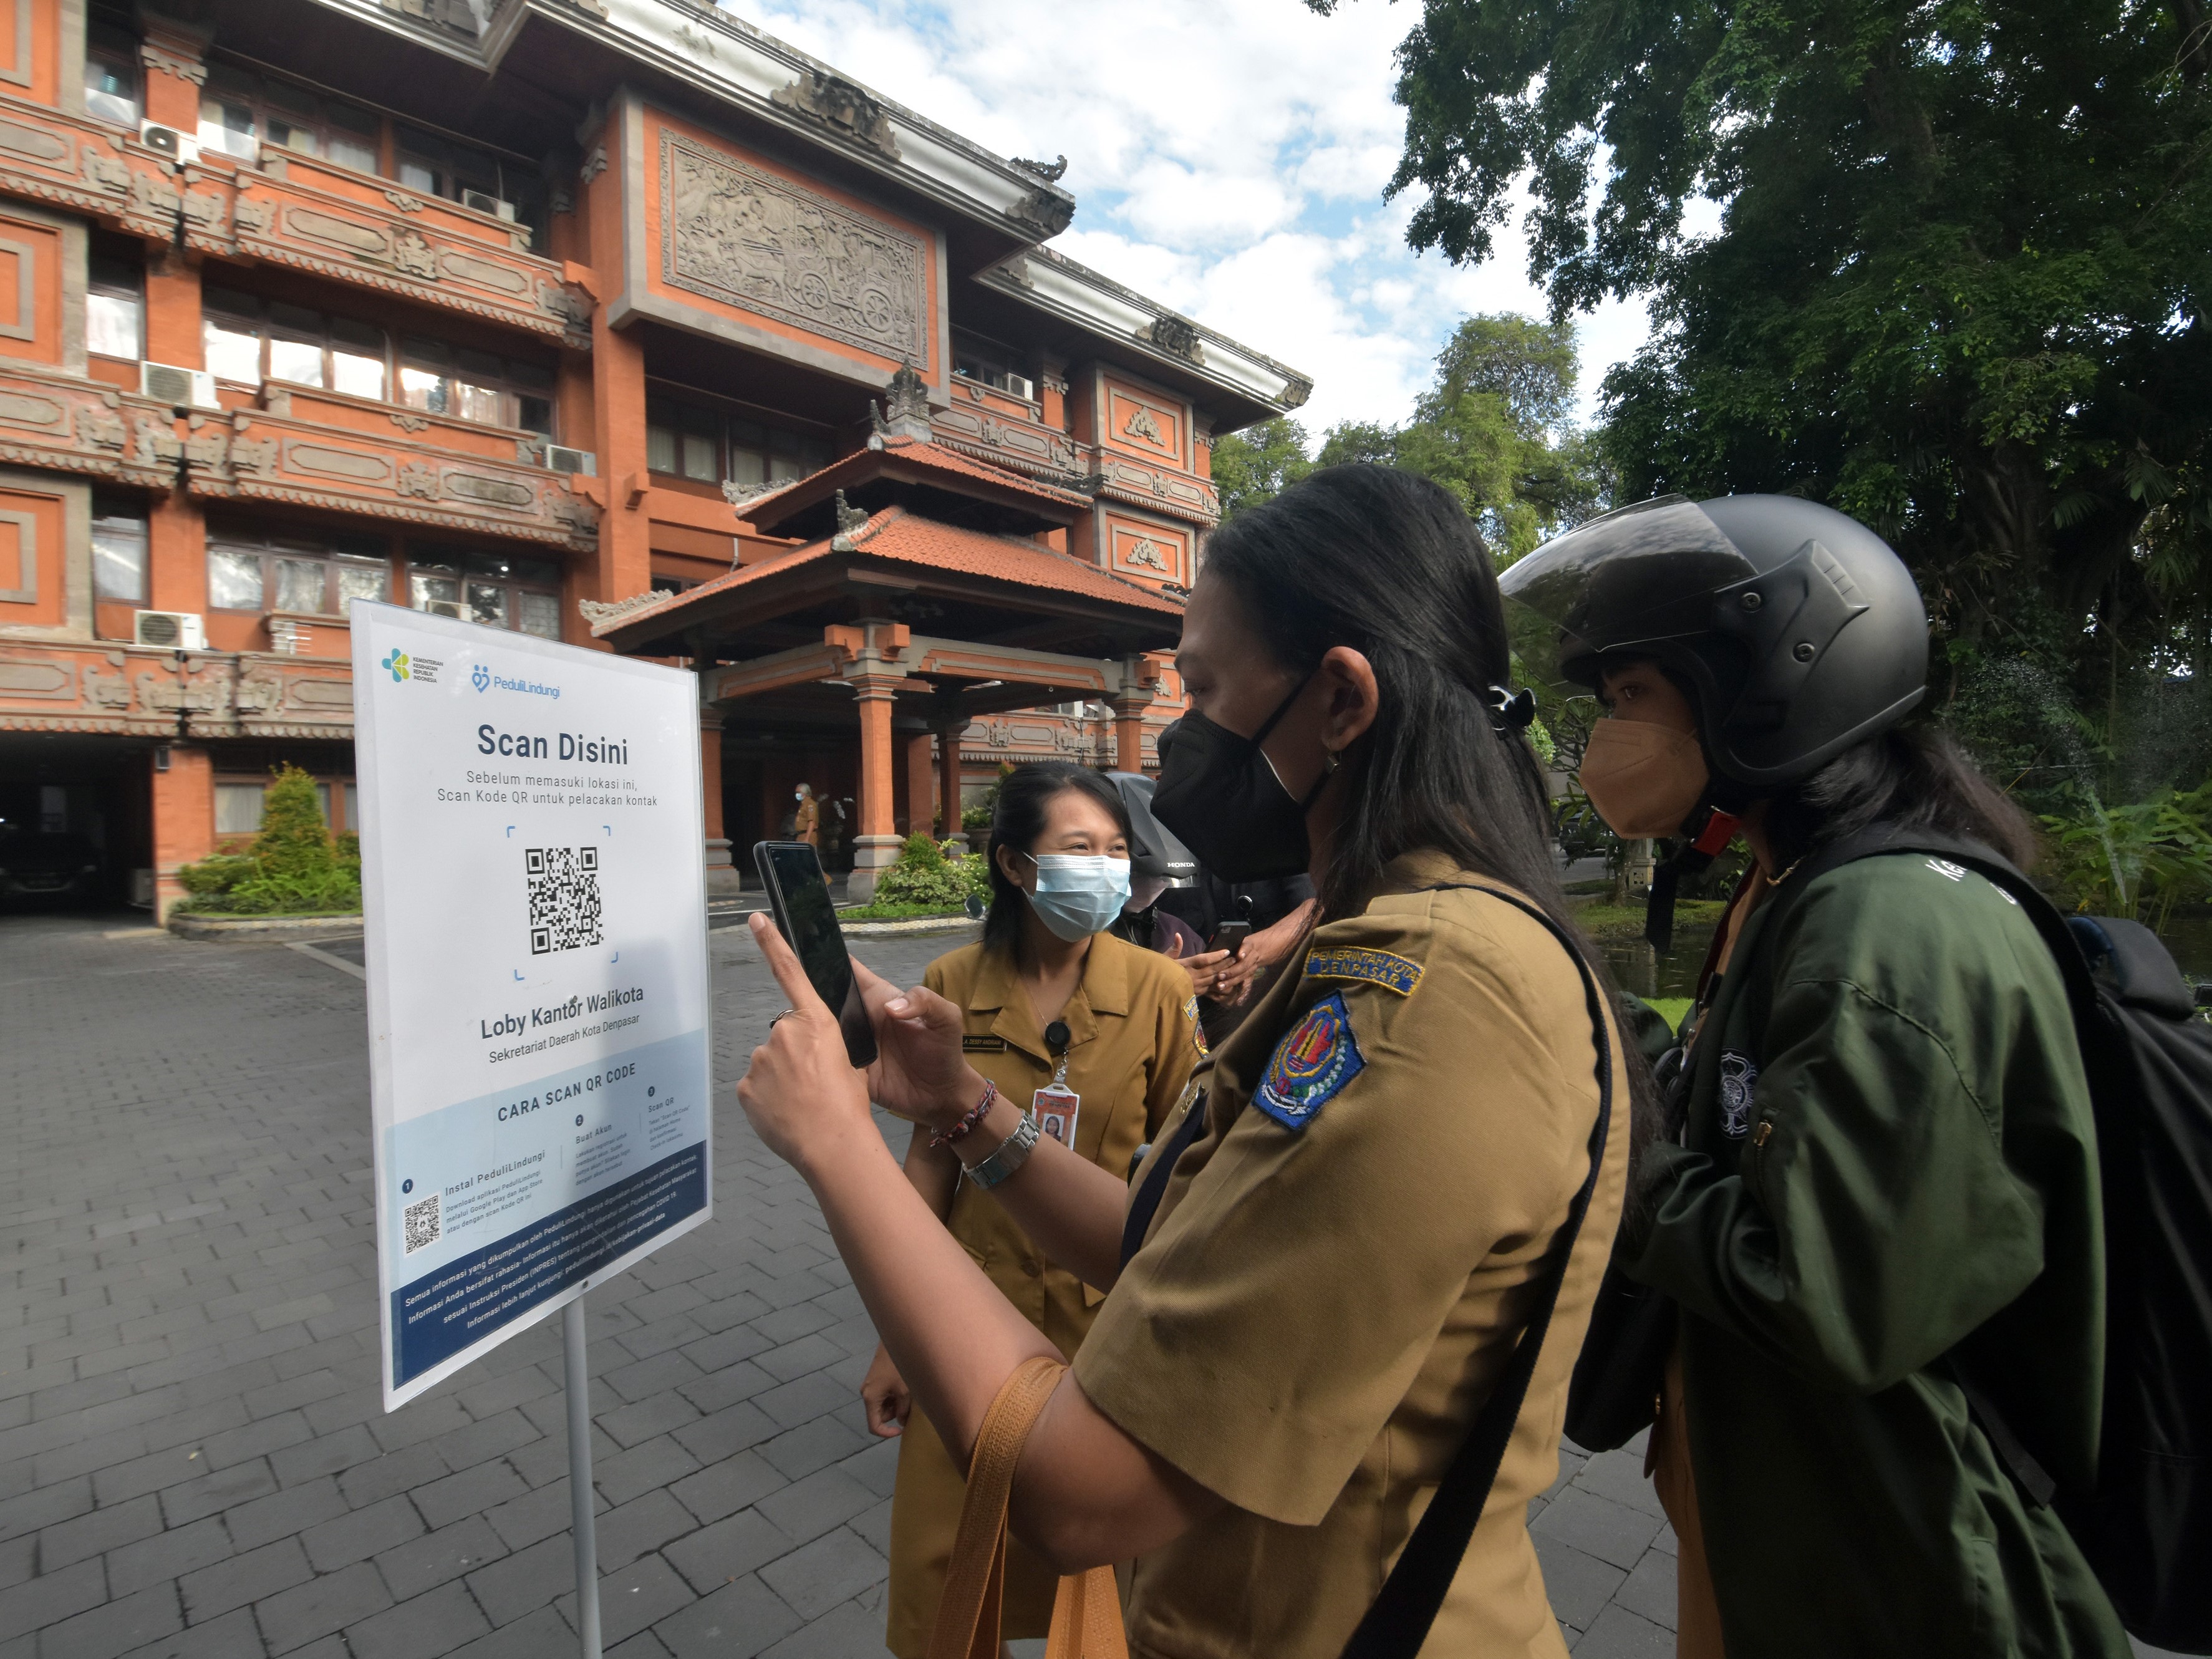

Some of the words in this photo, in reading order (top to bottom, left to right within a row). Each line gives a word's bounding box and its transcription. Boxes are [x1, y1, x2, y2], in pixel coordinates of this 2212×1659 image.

[413, 657, 443, 667] KEMENTERIAN
[413, 663, 438, 671] KESEHATAN
[494, 676, 560, 699] PeduliLindungi
[478, 724, 548, 759] Scan
[559, 732, 627, 765] Disini
[437, 788, 470, 802] Scan
[476, 790, 507, 803] Kode
[512, 791, 528, 804] QR
[533, 793, 564, 805] untuk
[569, 793, 622, 807] pelacakan
[626, 795, 657, 806] kontak
[467, 770, 520, 785] Sebelum
[526, 776, 583, 788] memasuki
[589, 777, 619, 789] lokasi
[623, 780, 637, 791] ini,
[1311, 950, 1386, 967] PEMERINTAH
[1386, 960, 1419, 982] KOTA
[1320, 962, 1401, 985] DENPASAR
[481, 1013, 526, 1039] Loby
[532, 1002, 583, 1027] Kantor
[587, 987, 644, 1013] Walikota
[489, 1039, 547, 1063] Sekretariat
[549, 1029, 580, 1048] Daerah
[582, 1025, 601, 1038] Kota
[602, 1015, 640, 1033] Denpasar
[498, 1096, 540, 1121] CARA
[546, 1081, 581, 1106] SCAN
[586, 1075, 602, 1092] QR
[606, 1063, 635, 1084] CODE
[648, 1103, 664, 1113] Scan
[665, 1097, 674, 1106] QR
[576, 1131, 592, 1144] Buat
[595, 1124, 612, 1136] Akun
[445, 1177, 473, 1196] Instal
[478, 1150, 544, 1183] PeduliLindungi
[446, 1196, 475, 1212] Download
[477, 1186, 500, 1199] aplikasi
[502, 1169, 540, 1189] PeduliLindungi
[447, 1209, 468, 1223] melalui
[470, 1201, 491, 1213] Google
[493, 1195, 505, 1203] Play
[529, 1179, 543, 1187] Store
[447, 1224, 460, 1234] atau
[461, 1214, 483, 1227] dengan
[486, 1207, 498, 1217] scan
[501, 1201, 514, 1210] Kode
[405, 1289, 430, 1307] Semua
[432, 1269, 466, 1292] informasi
[469, 1260, 485, 1276] yang
[488, 1239, 528, 1264] dikumpulkan
[530, 1231, 542, 1242] oleh
[544, 1209, 586, 1235] PeduliLindungi
[408, 1299, 443, 1324] Informasi
[445, 1289, 463, 1304] Anda
[466, 1273, 493, 1294] bersifat
[496, 1260, 521, 1278] rahasia-
[523, 1242, 550, 1264] Informasi
[561, 1229, 578, 1242] hanya
[443, 1304, 467, 1324] sesuai
[470, 1287, 499, 1310] Instruksi
[501, 1272, 528, 1292] Presiden
[529, 1255, 556, 1278] (INPRES)
[558, 1245, 579, 1260] tentang
[656, 1194, 669, 1207] COVID
[467, 1304, 500, 1328] Informasi
[502, 1294, 517, 1309] lebih
[519, 1284, 536, 1299] lanjut
